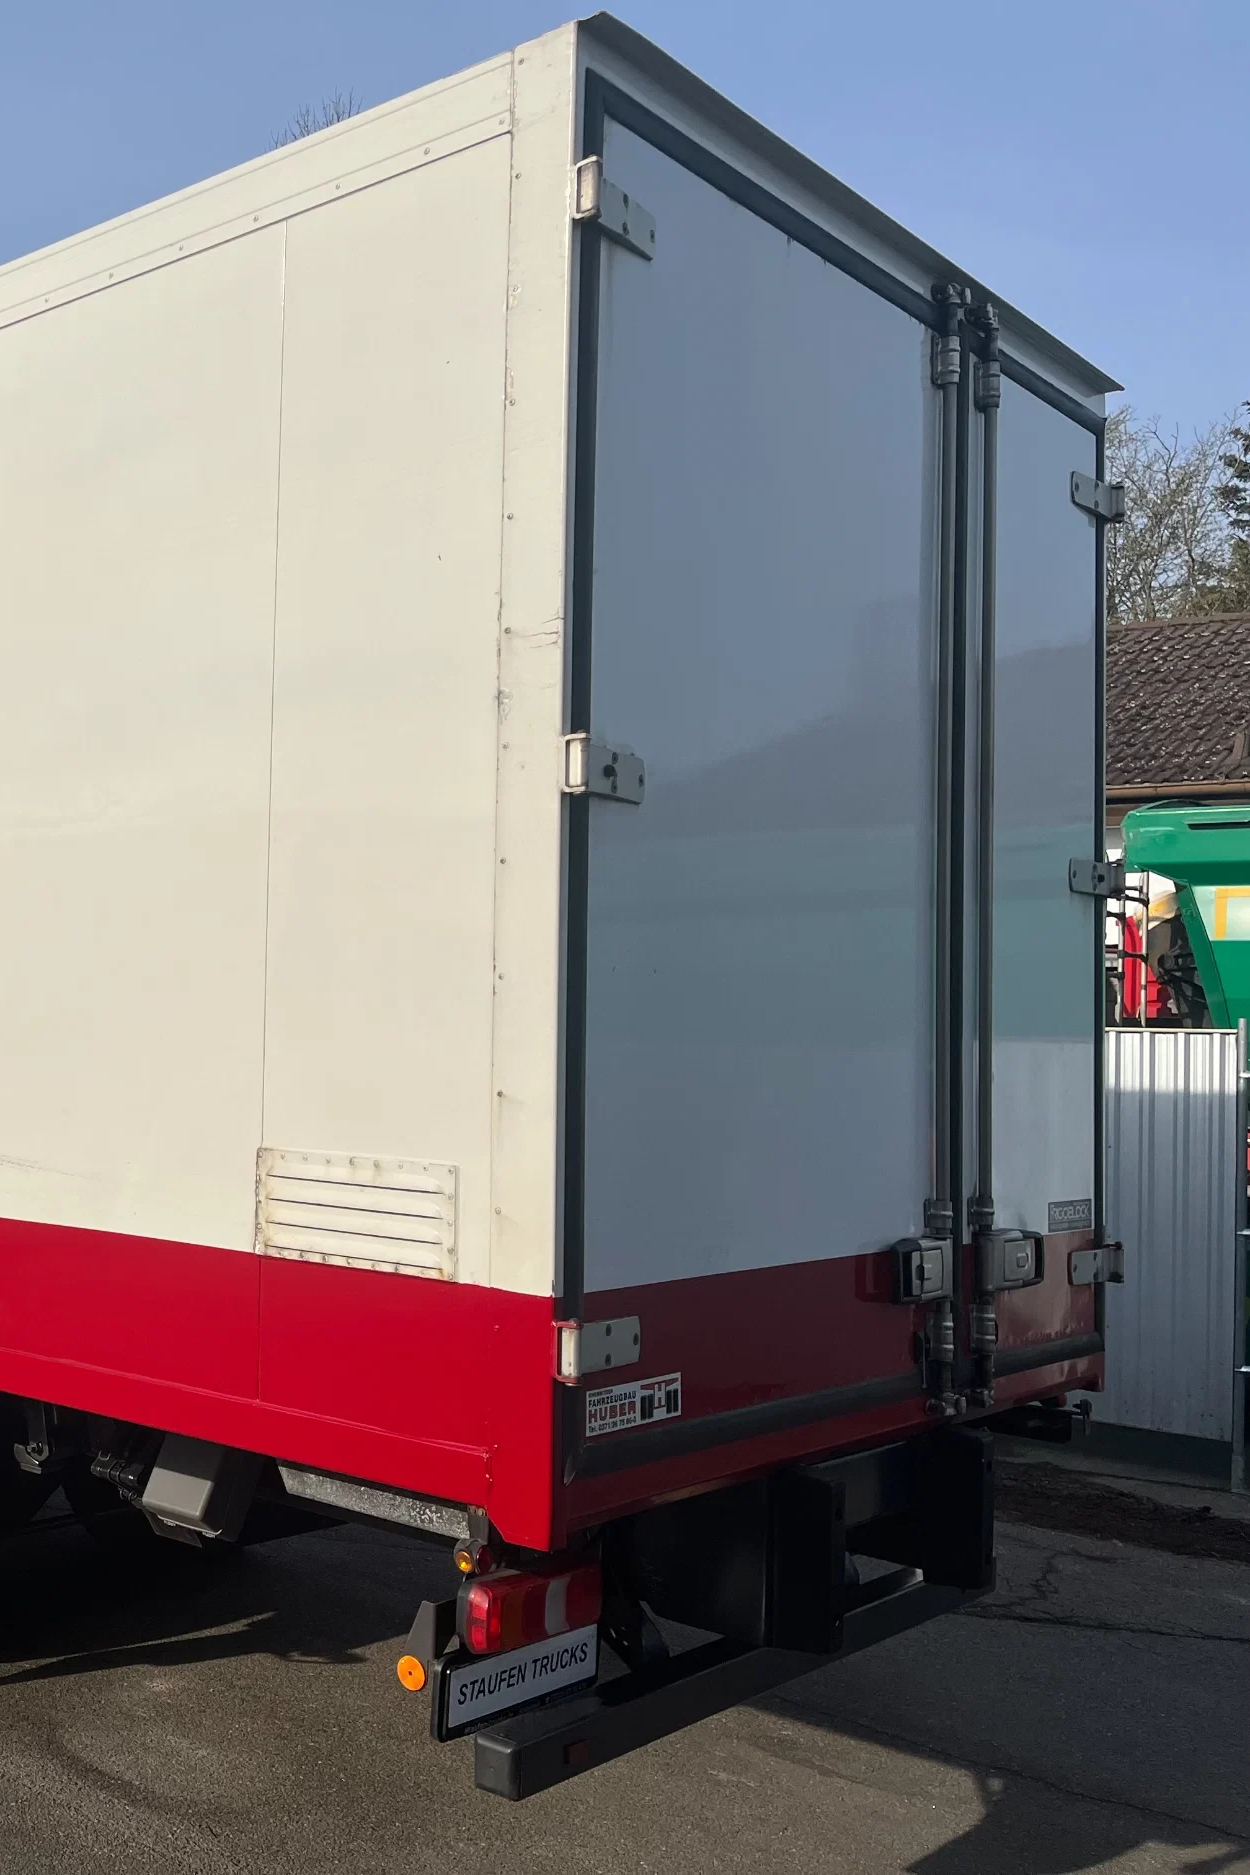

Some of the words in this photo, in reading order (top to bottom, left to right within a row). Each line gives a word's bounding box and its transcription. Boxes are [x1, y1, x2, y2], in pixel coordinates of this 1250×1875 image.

[588, 1391, 637, 1408] FAHRZEUGBAU
[588, 1401, 636, 1424] HUBER
[458, 1662, 527, 1705] STAUFEN
[532, 1643, 588, 1680] TRUCKS
